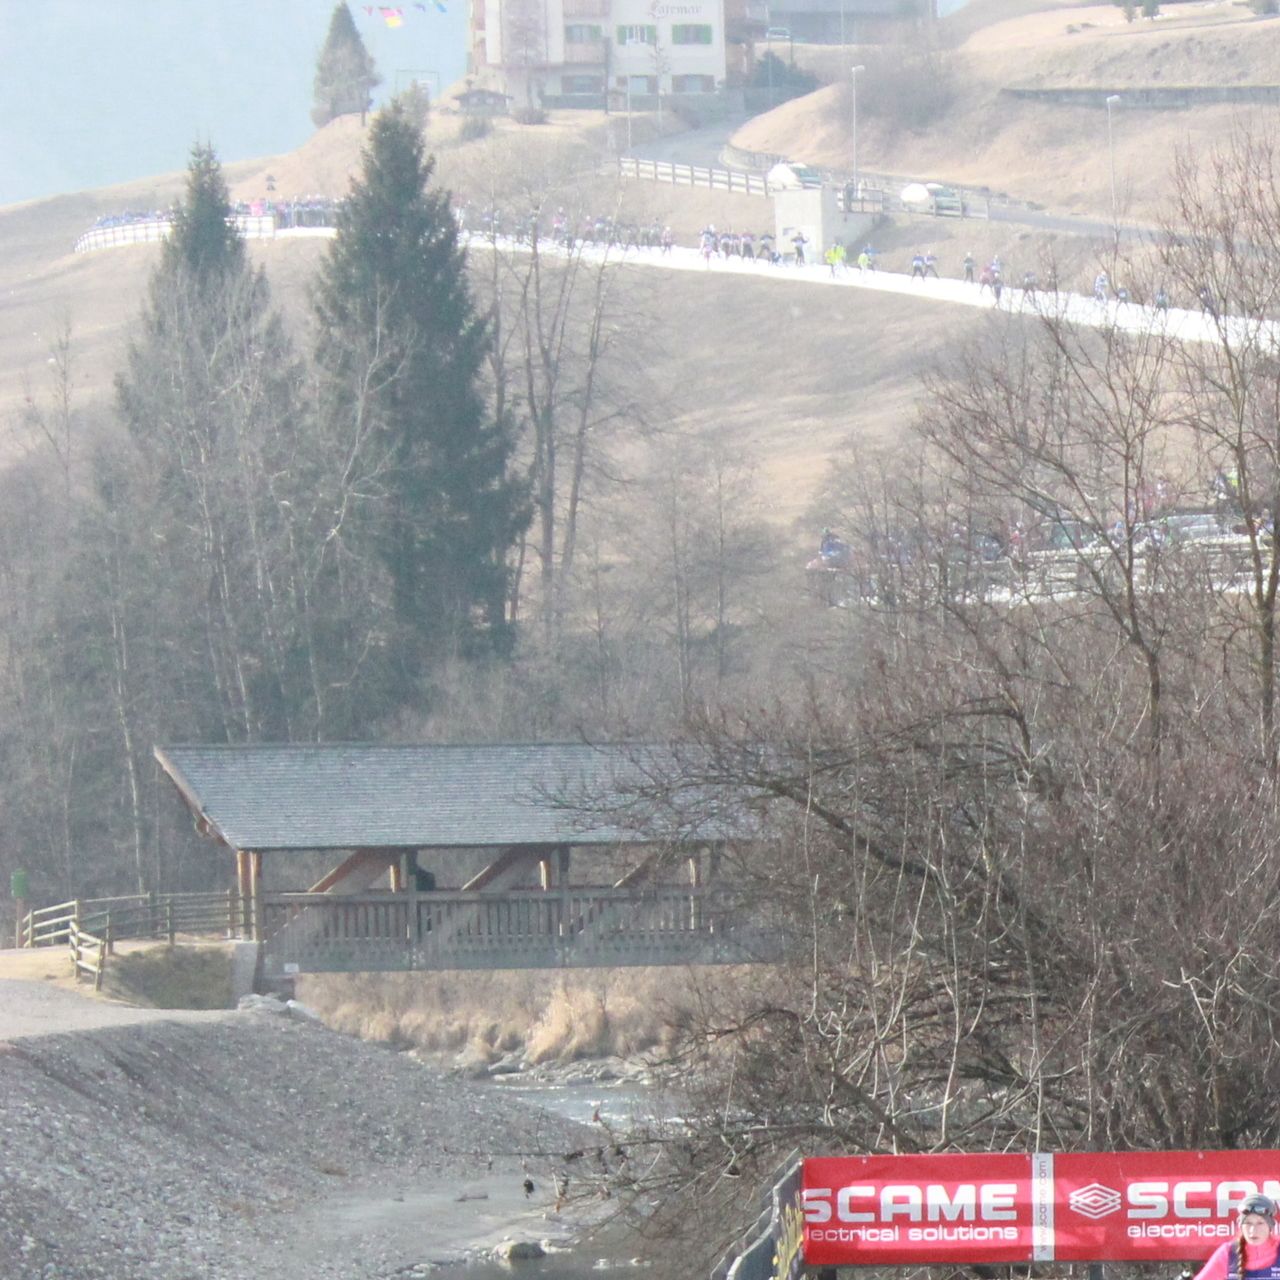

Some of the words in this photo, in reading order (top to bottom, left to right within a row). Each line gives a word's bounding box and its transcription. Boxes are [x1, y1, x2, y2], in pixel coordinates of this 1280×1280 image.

[804, 1183, 1018, 1223] SCAME
[806, 1225, 900, 1242] lectrical
[908, 1224, 1019, 1241] solutions
[1127, 1220, 1235, 1238] electrical
